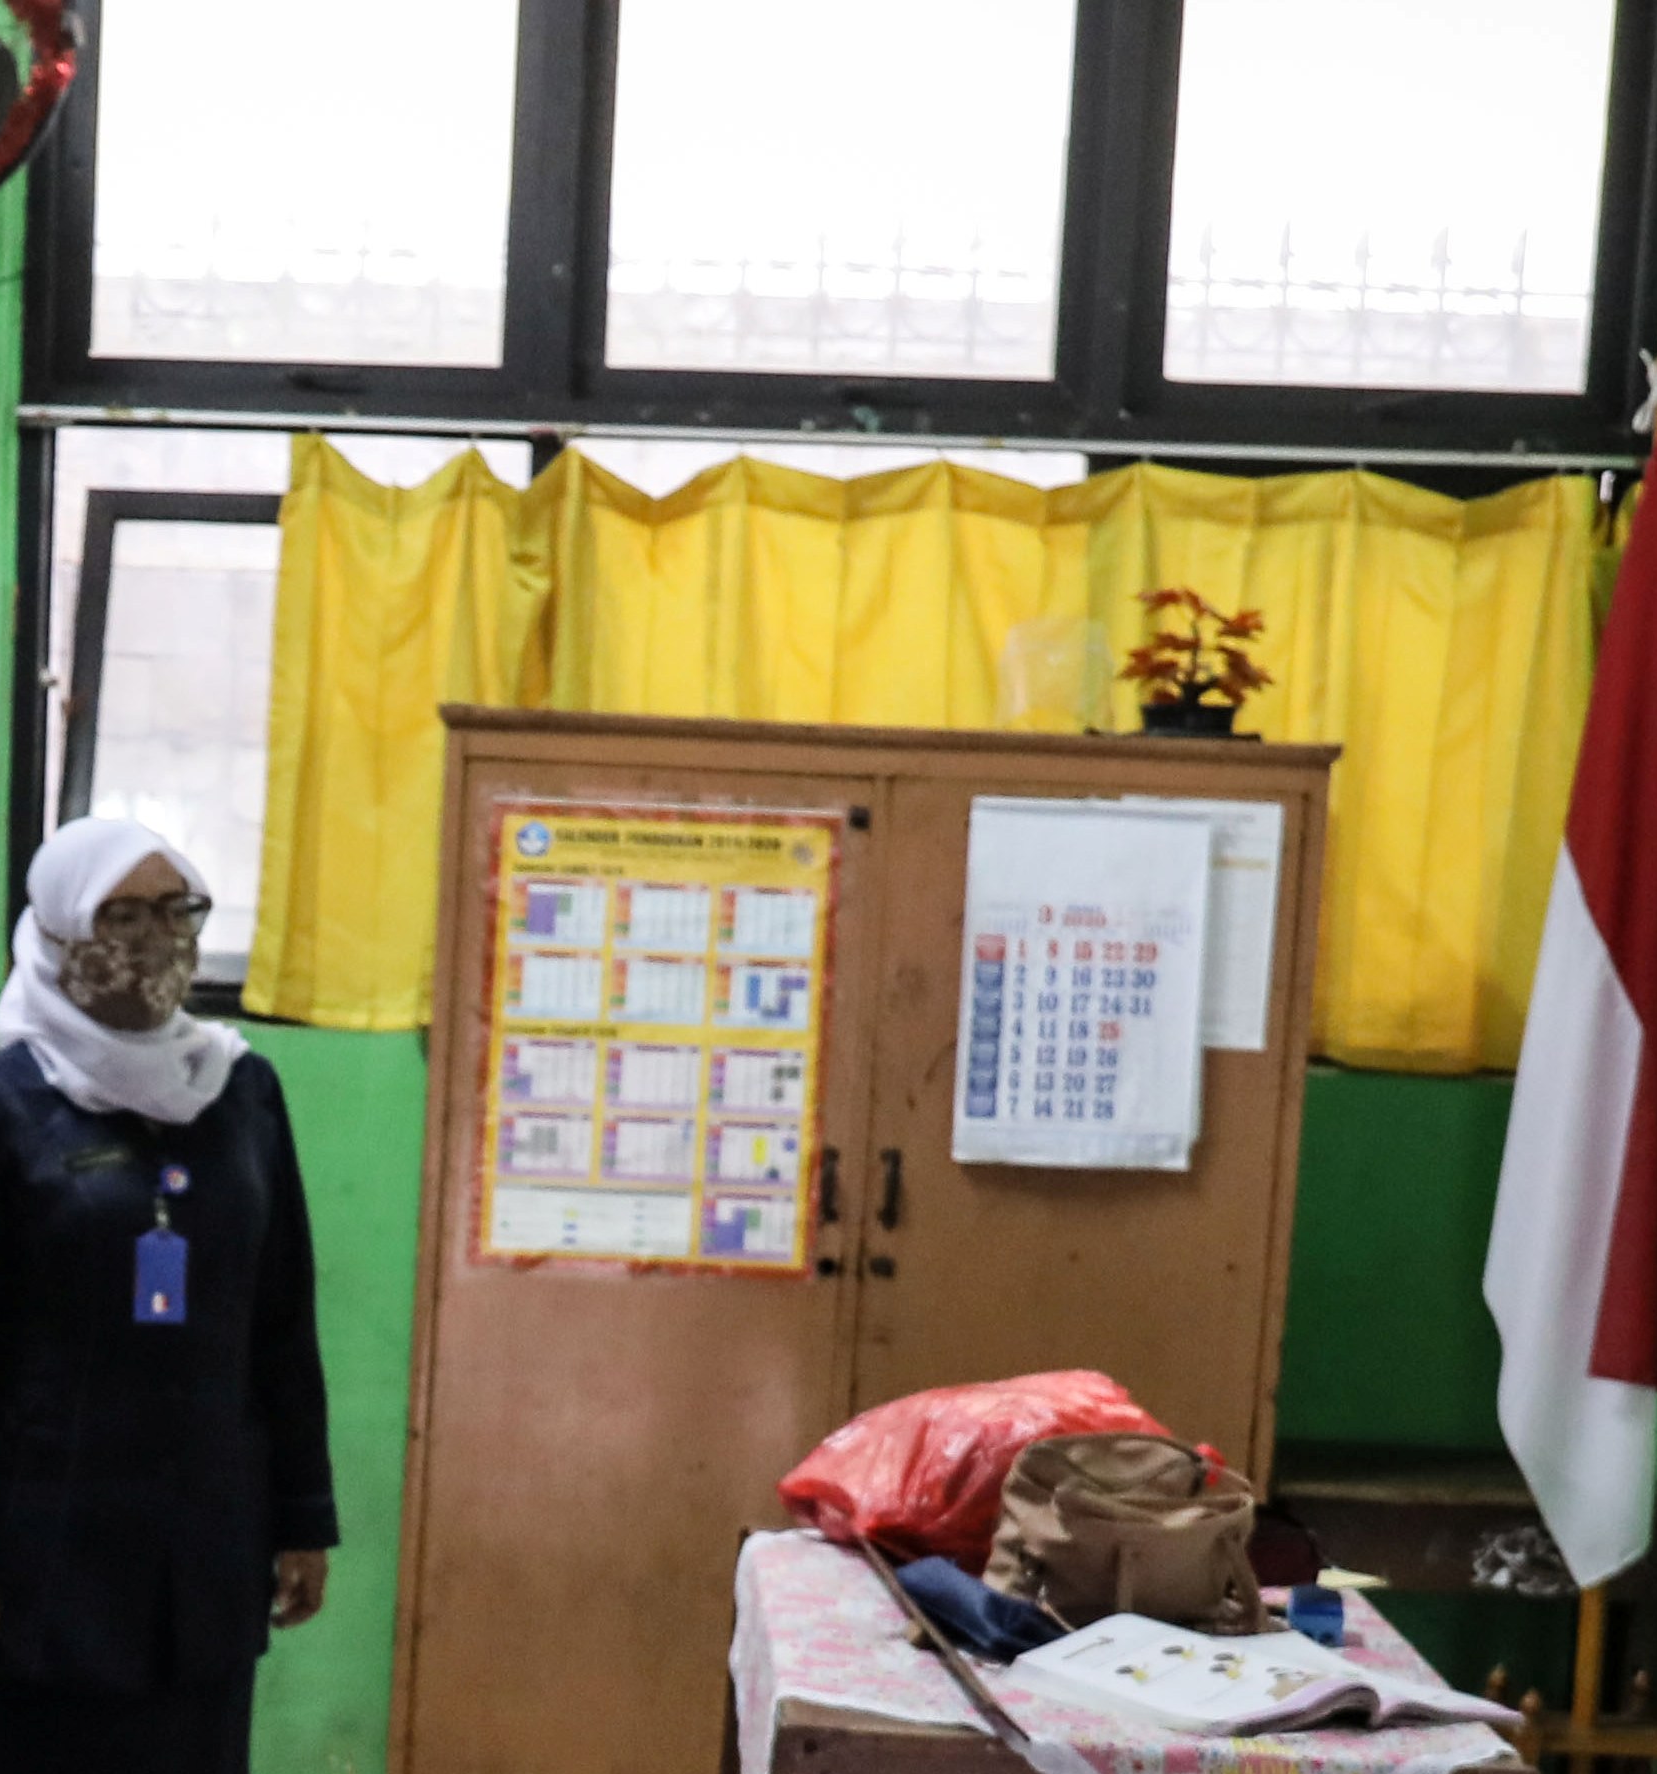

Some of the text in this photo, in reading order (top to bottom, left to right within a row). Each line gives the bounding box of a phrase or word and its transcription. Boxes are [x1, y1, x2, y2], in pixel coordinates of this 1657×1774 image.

[1018, 937, 1027, 959] 1
[1047, 938, 1059, 960] 8
[1073, 939, 1093, 962] 15
[1101, 940, 1126, 963] 22
[1133, 941, 1158, 964] 29
[1014, 963, 1157, 990] 2 9 16 23 30
[1012, 990, 1152, 1017] 3 10 17 24 31
[1011, 1017, 1122, 1041] 4 11 18 25
[1009, 1042, 1119, 1069] 5 12 19 26
[1008, 1068, 1117, 1095] 6 13 20 27
[1009, 1094, 1115, 1121] 7 14 21 28
